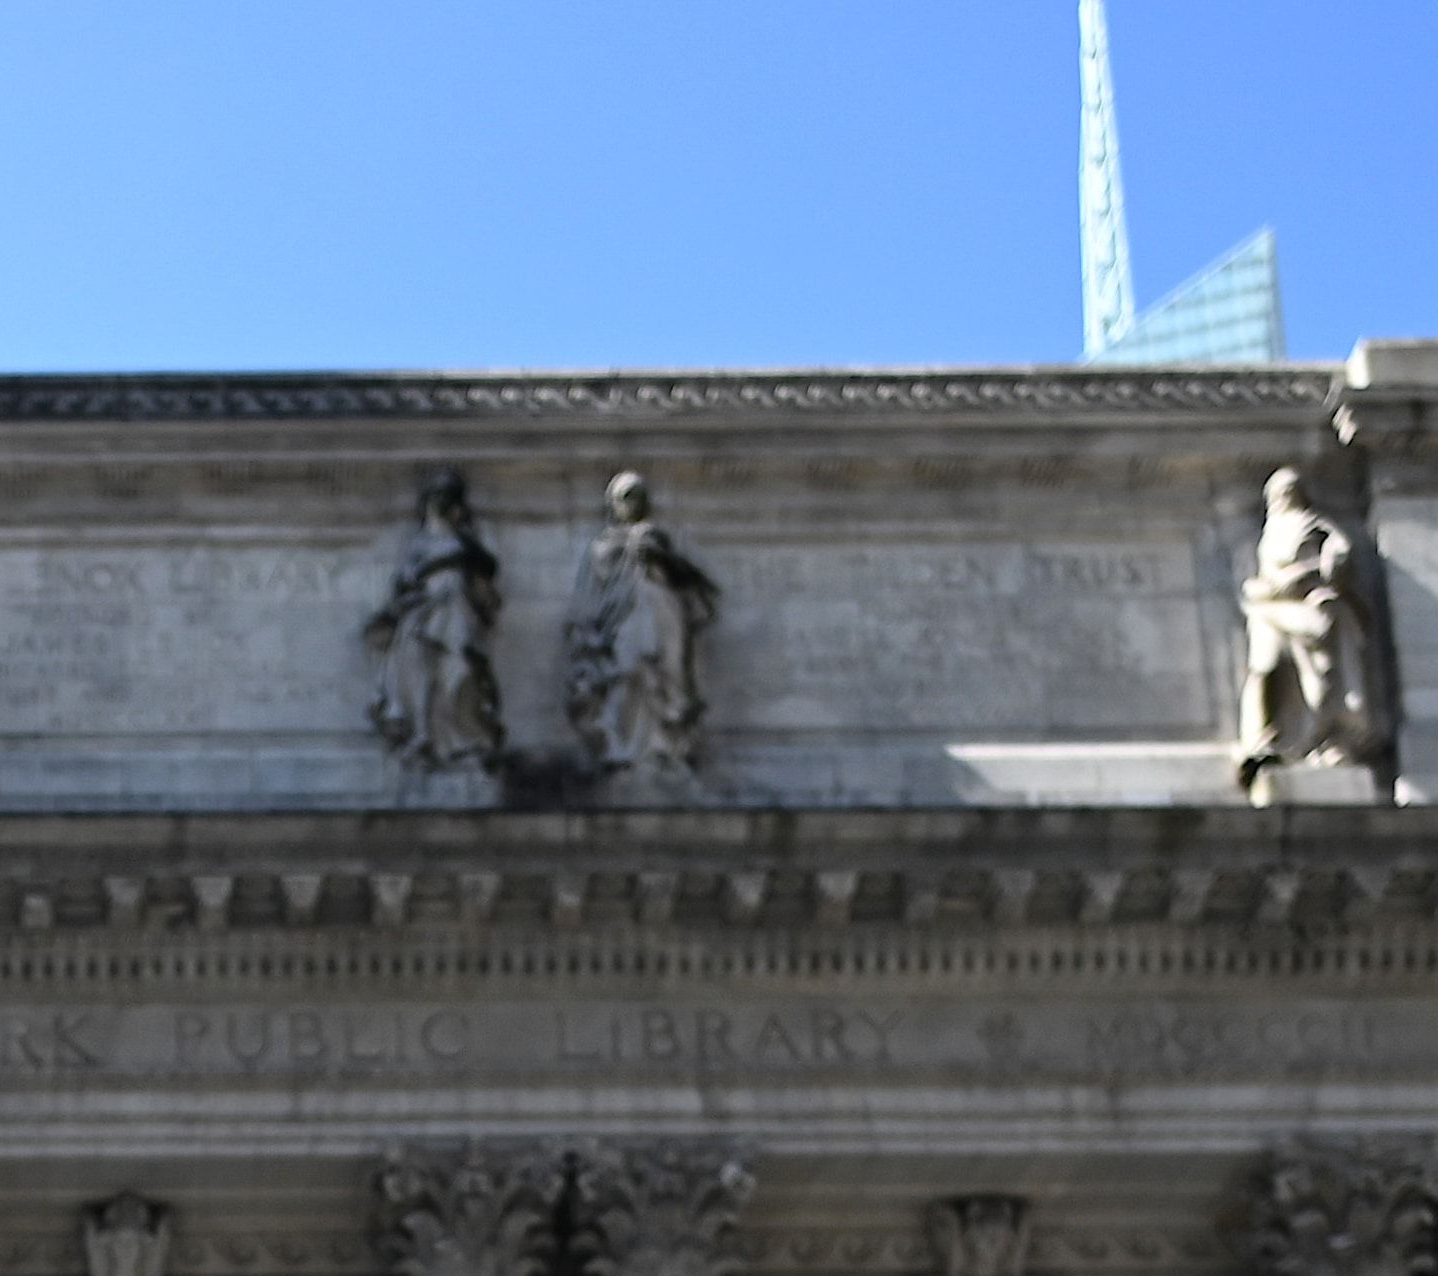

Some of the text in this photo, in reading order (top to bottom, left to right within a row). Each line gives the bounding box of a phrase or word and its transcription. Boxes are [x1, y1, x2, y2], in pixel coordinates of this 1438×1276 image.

[169, 556, 341, 593] LIBRARY
[1032, 550, 1166, 588] TRUST
[172, 1010, 471, 1069] PUBLIC
[555, 1007, 906, 1066] LIBRARY
